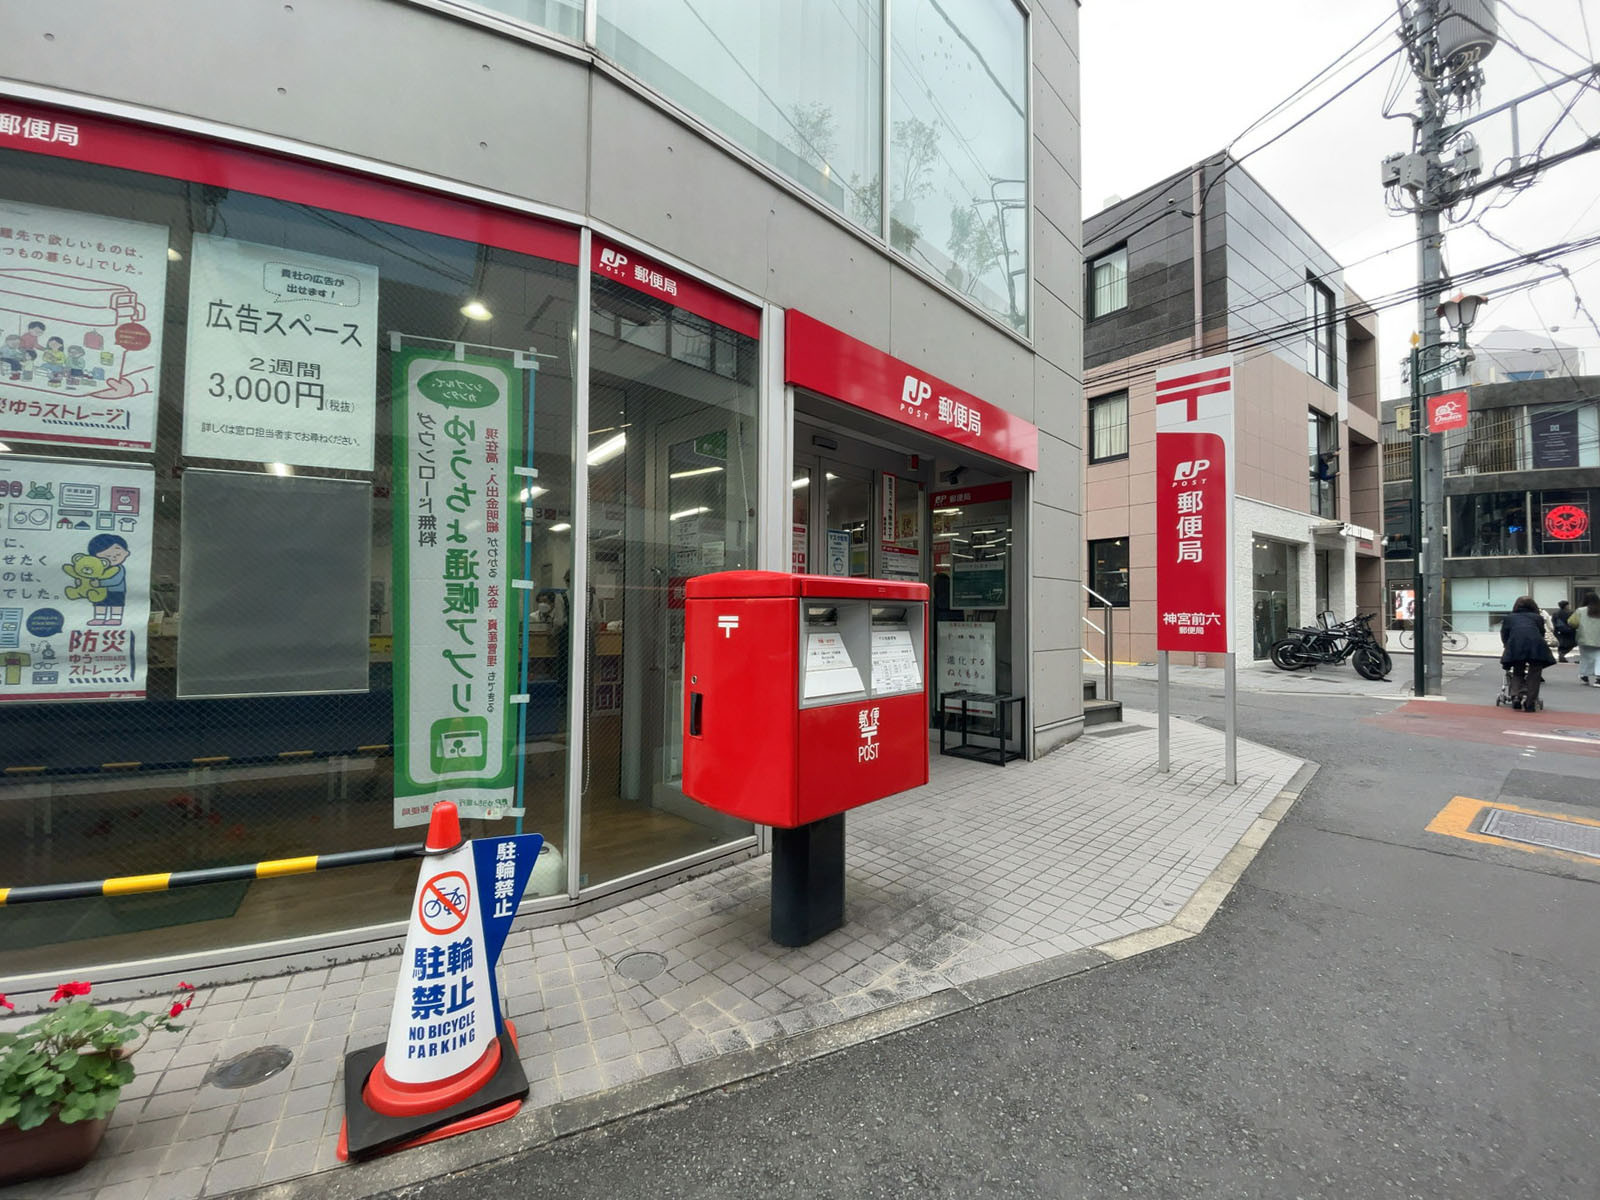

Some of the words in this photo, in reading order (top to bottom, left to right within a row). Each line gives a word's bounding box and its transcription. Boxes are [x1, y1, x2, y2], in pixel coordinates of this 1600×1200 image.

[0, 112, 79, 147] 郵便局
[0, 246, 144, 276] つもの暮らし」でした。
[600, 247, 628, 268] JP
[634, 264, 678, 297] 郵便局
[205, 298, 363, 348] 広告スペース
[248, 355, 322, 381] 2週間
[208, 372, 326, 412] 3,000円
[901, 375, 932, 406] JP
[899, 402, 930, 421] POST
[938, 394, 981, 438] 郵便局
[201, 421, 361, 447] 詳しくは窓口担当者までお尋ねください。
[1172, 478, 1208, 488] POST
[1174, 459, 1210, 481] JP
[1176, 489, 1204, 564] 郵便局
[3, 554, 48, 566] せたく
[3, 588, 60, 600] でした。
[1162, 612, 1221, 627] 神宮前六
[1178, 625, 1205, 636] 郵便局
[68, 629, 127, 653] 防災
[68, 654, 93, 664] ゆう
[69, 664, 128, 676] ストレージ
[858, 706, 880, 730] 郵便
[858, 742, 880, 764] POST
[493, 841, 518, 919] 駐輪禁止
[412, 936, 474, 982] 駐輪
[411, 975, 475, 1021] 禁止
[408, 1024, 425, 1041] NO
[428, 1009, 476, 1040] BICYCLE
[407, 1027, 476, 1060] PARKING
